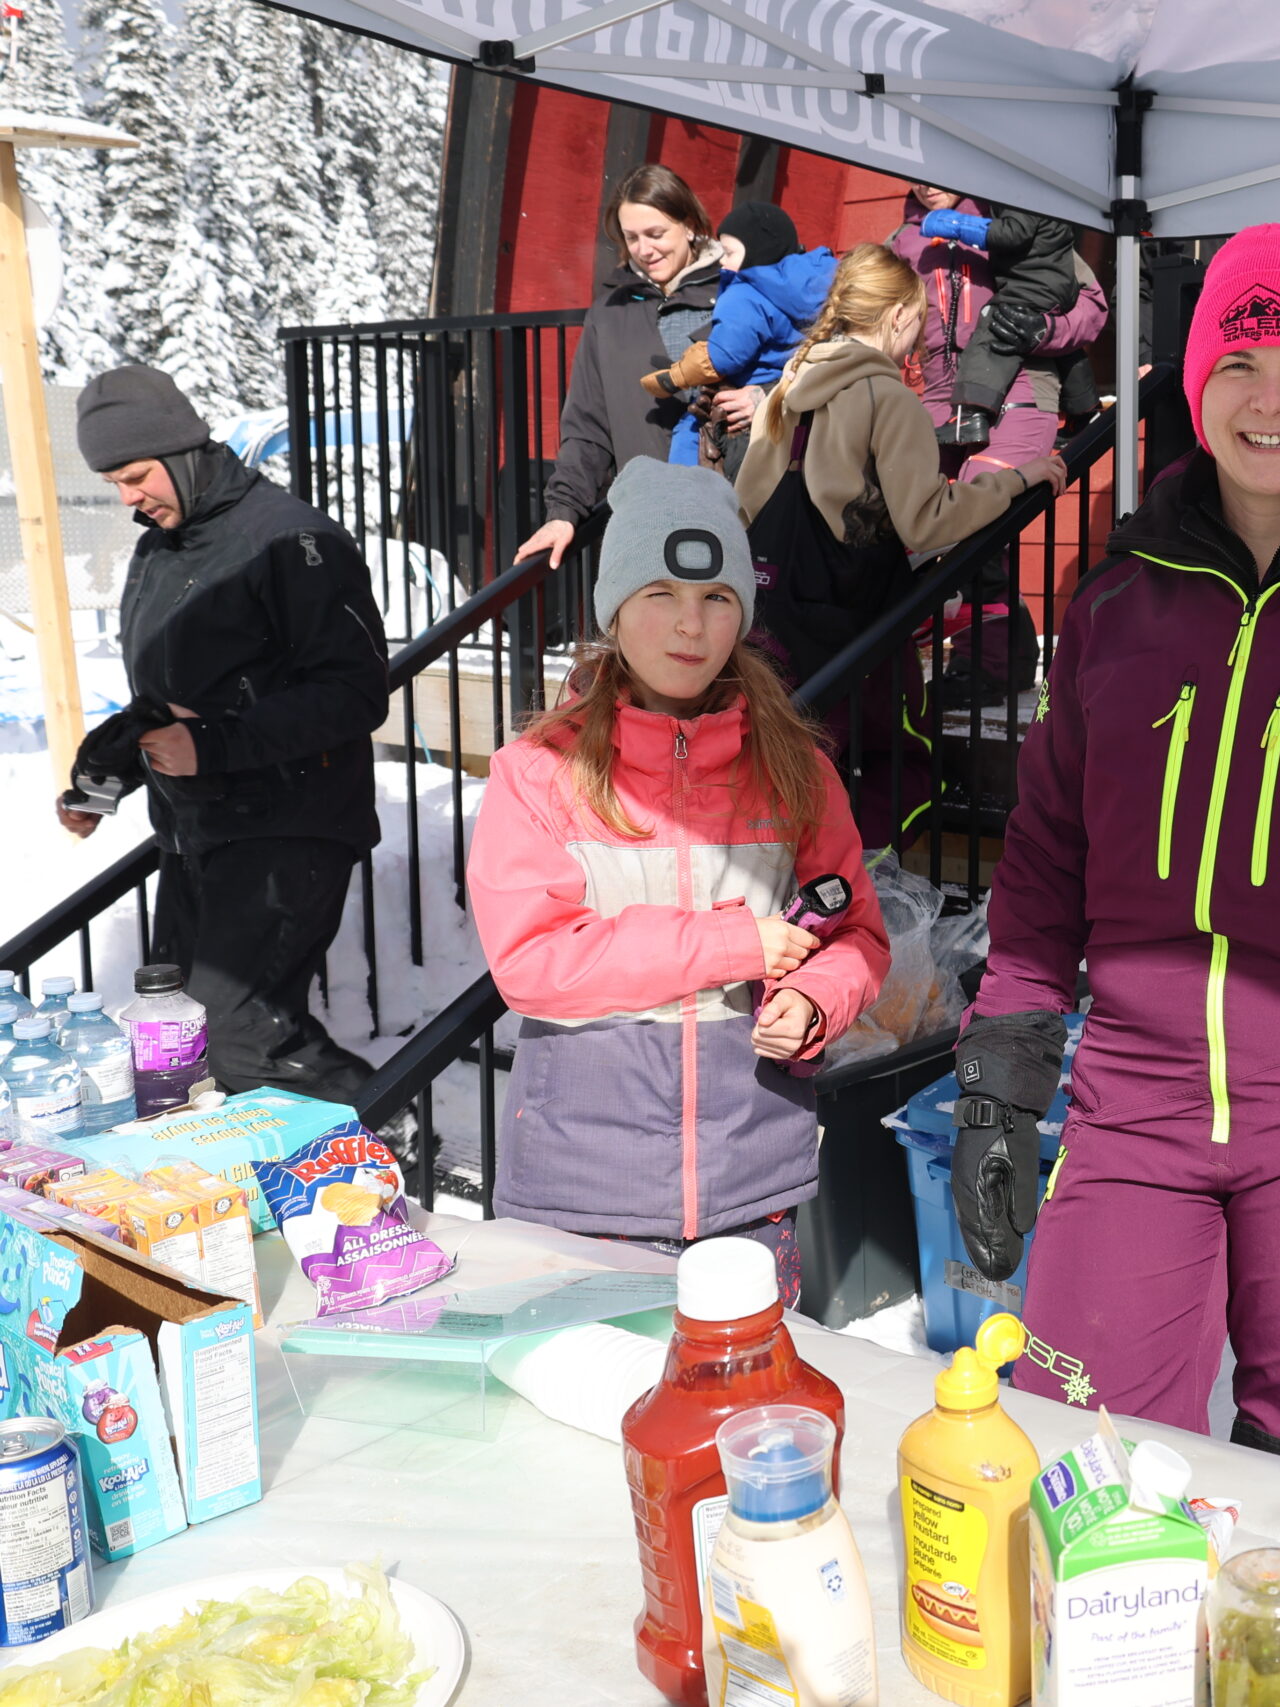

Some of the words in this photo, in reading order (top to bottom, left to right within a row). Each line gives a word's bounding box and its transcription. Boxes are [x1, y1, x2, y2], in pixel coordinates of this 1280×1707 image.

[1223, 331, 1262, 343] HUNTERS
[342, 1238, 366, 1253] ALL
[42, 1261, 71, 1291] Punch
[99, 1458, 150, 1493] Kool-Aid
[27, 1486, 47, 1498] Facts
[913, 1497, 942, 1519] prepared
[913, 1510, 939, 1529] yellow
[913, 1520, 950, 1545] mustard
[913, 1535, 958, 1564] moutarde
[913, 1545, 936, 1566] jaune
[1068, 1579, 1200, 1620] Dairyland
[1117, 1631, 1128, 1643] of
